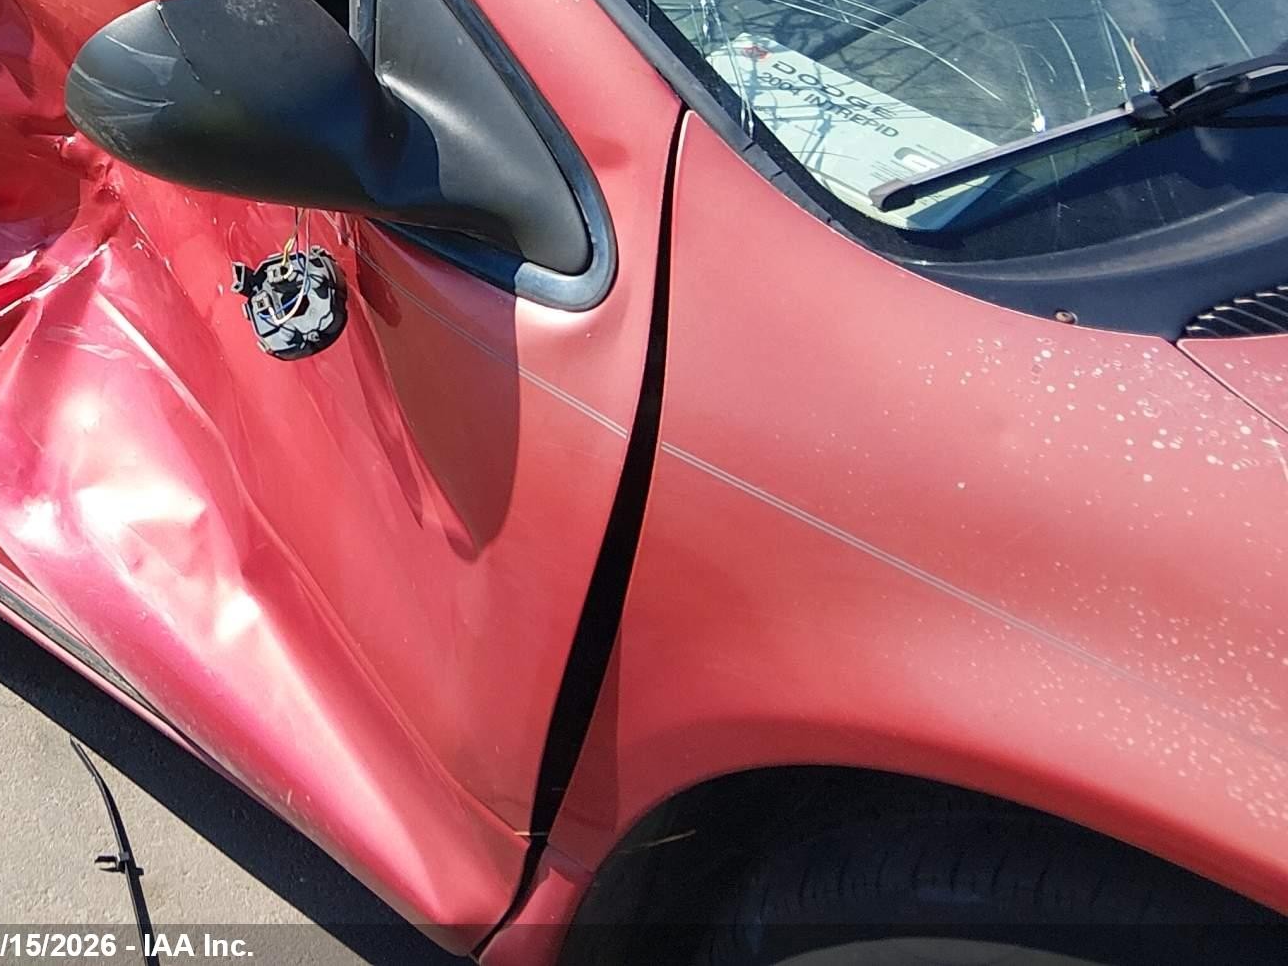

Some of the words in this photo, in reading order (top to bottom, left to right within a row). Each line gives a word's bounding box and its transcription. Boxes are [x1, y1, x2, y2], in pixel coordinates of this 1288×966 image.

[759, 72, 801, 96] 2004
[803, 93, 900, 138] INTREPID
[772, 60, 897, 120] DODGE
